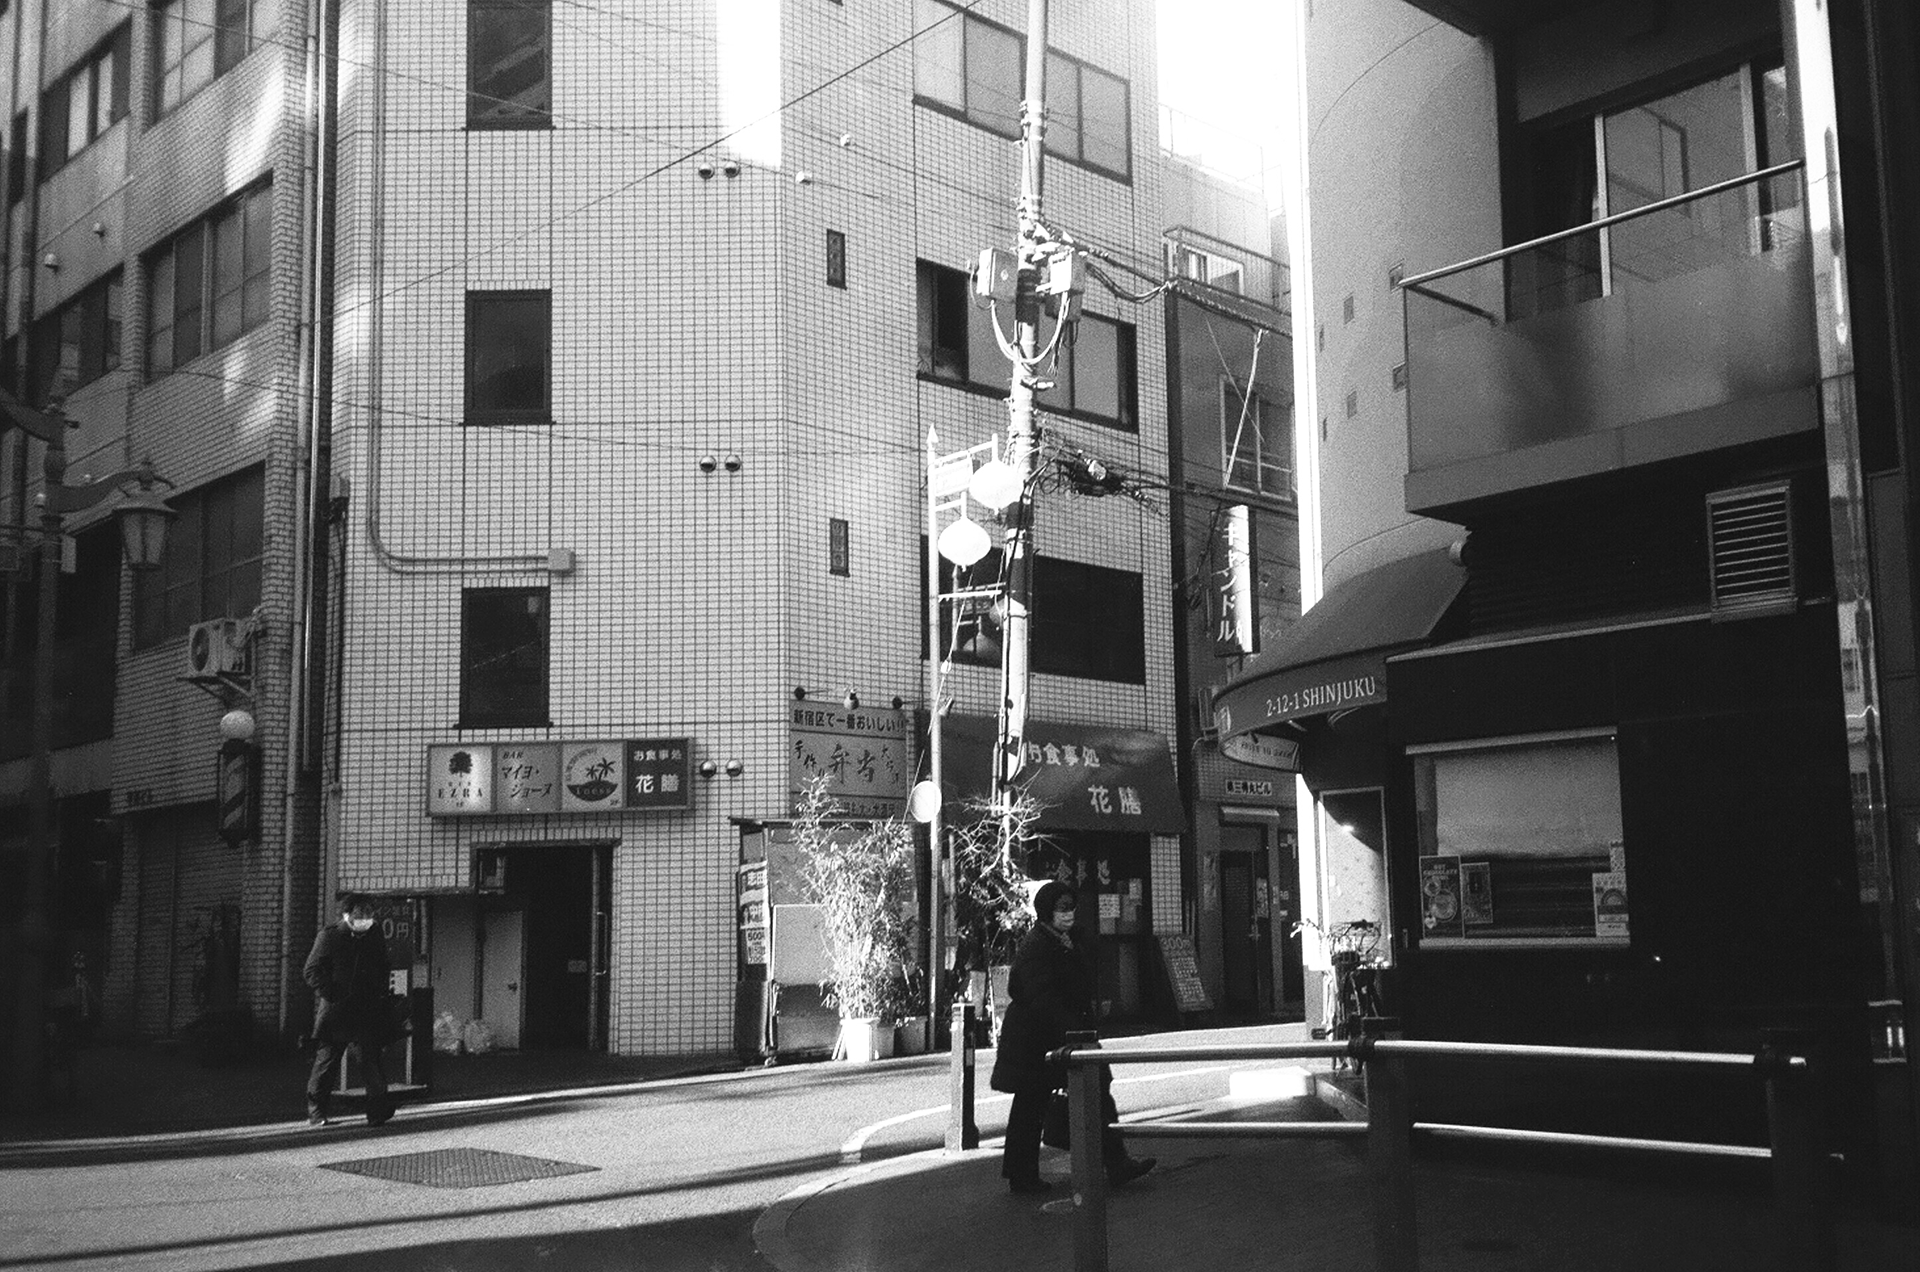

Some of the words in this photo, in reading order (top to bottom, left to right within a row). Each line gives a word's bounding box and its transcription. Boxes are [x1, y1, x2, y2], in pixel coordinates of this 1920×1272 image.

[1266, 692, 1300, 717] 2-12-1
[1302, 676, 1376, 707] SHINJUKU
[633, 749, 682, 761] お食事処
[437, 788, 484, 799] EZRA
